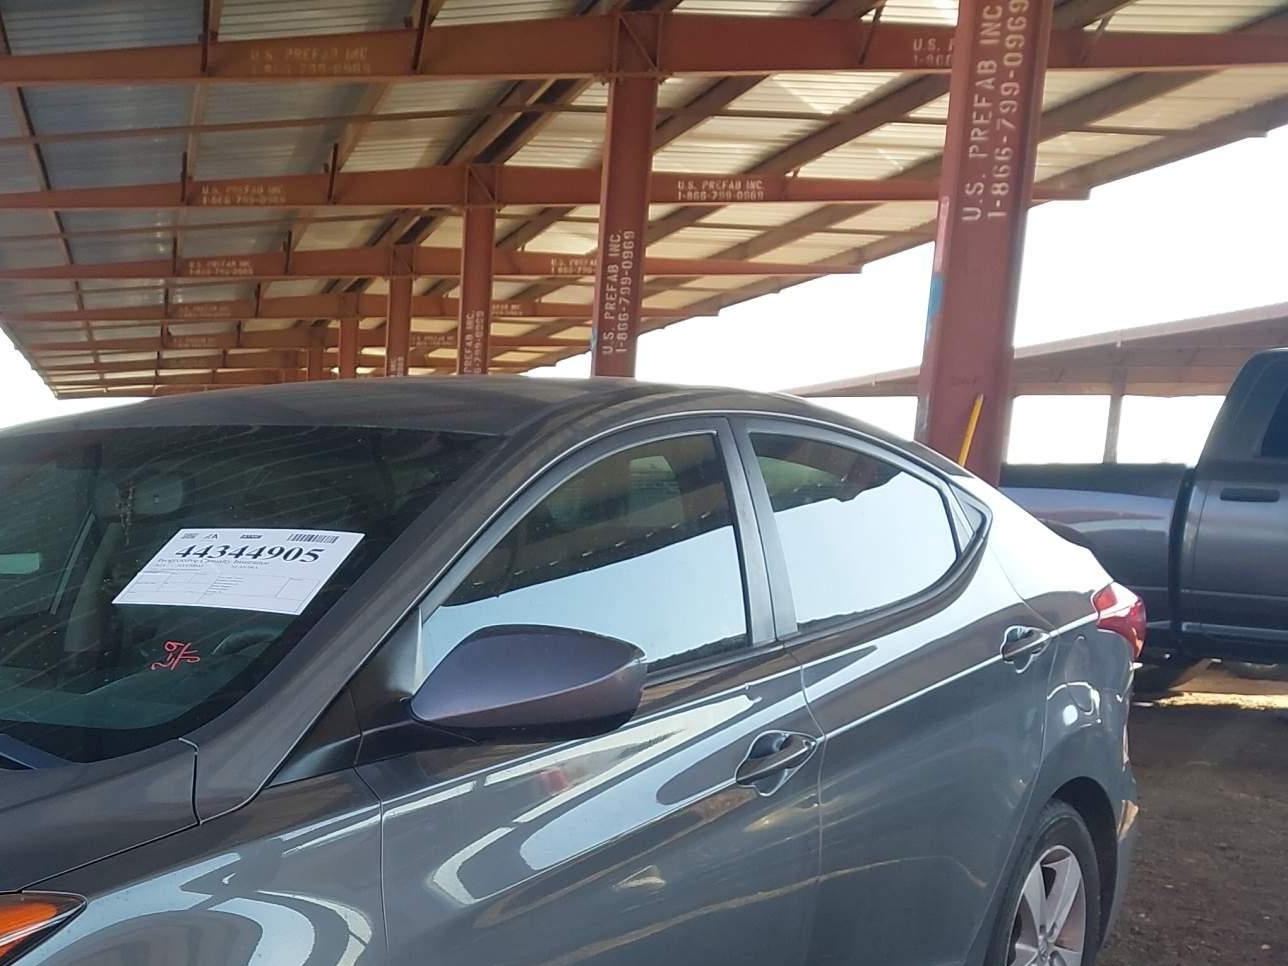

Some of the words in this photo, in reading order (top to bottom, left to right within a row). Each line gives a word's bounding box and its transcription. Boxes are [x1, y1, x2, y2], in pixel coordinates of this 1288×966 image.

[968, 59, 998, 159] PREFAB
[987, 0, 1030, 218] 1-866-799-0969
[702, 180, 742, 190] PREFAB
[962, 173, 986, 222] U.S.
[604, 263, 619, 320] PREFAB
[615, 231, 635, 352] 1-866-799-0969
[175, 545, 325, 563] 44344905
